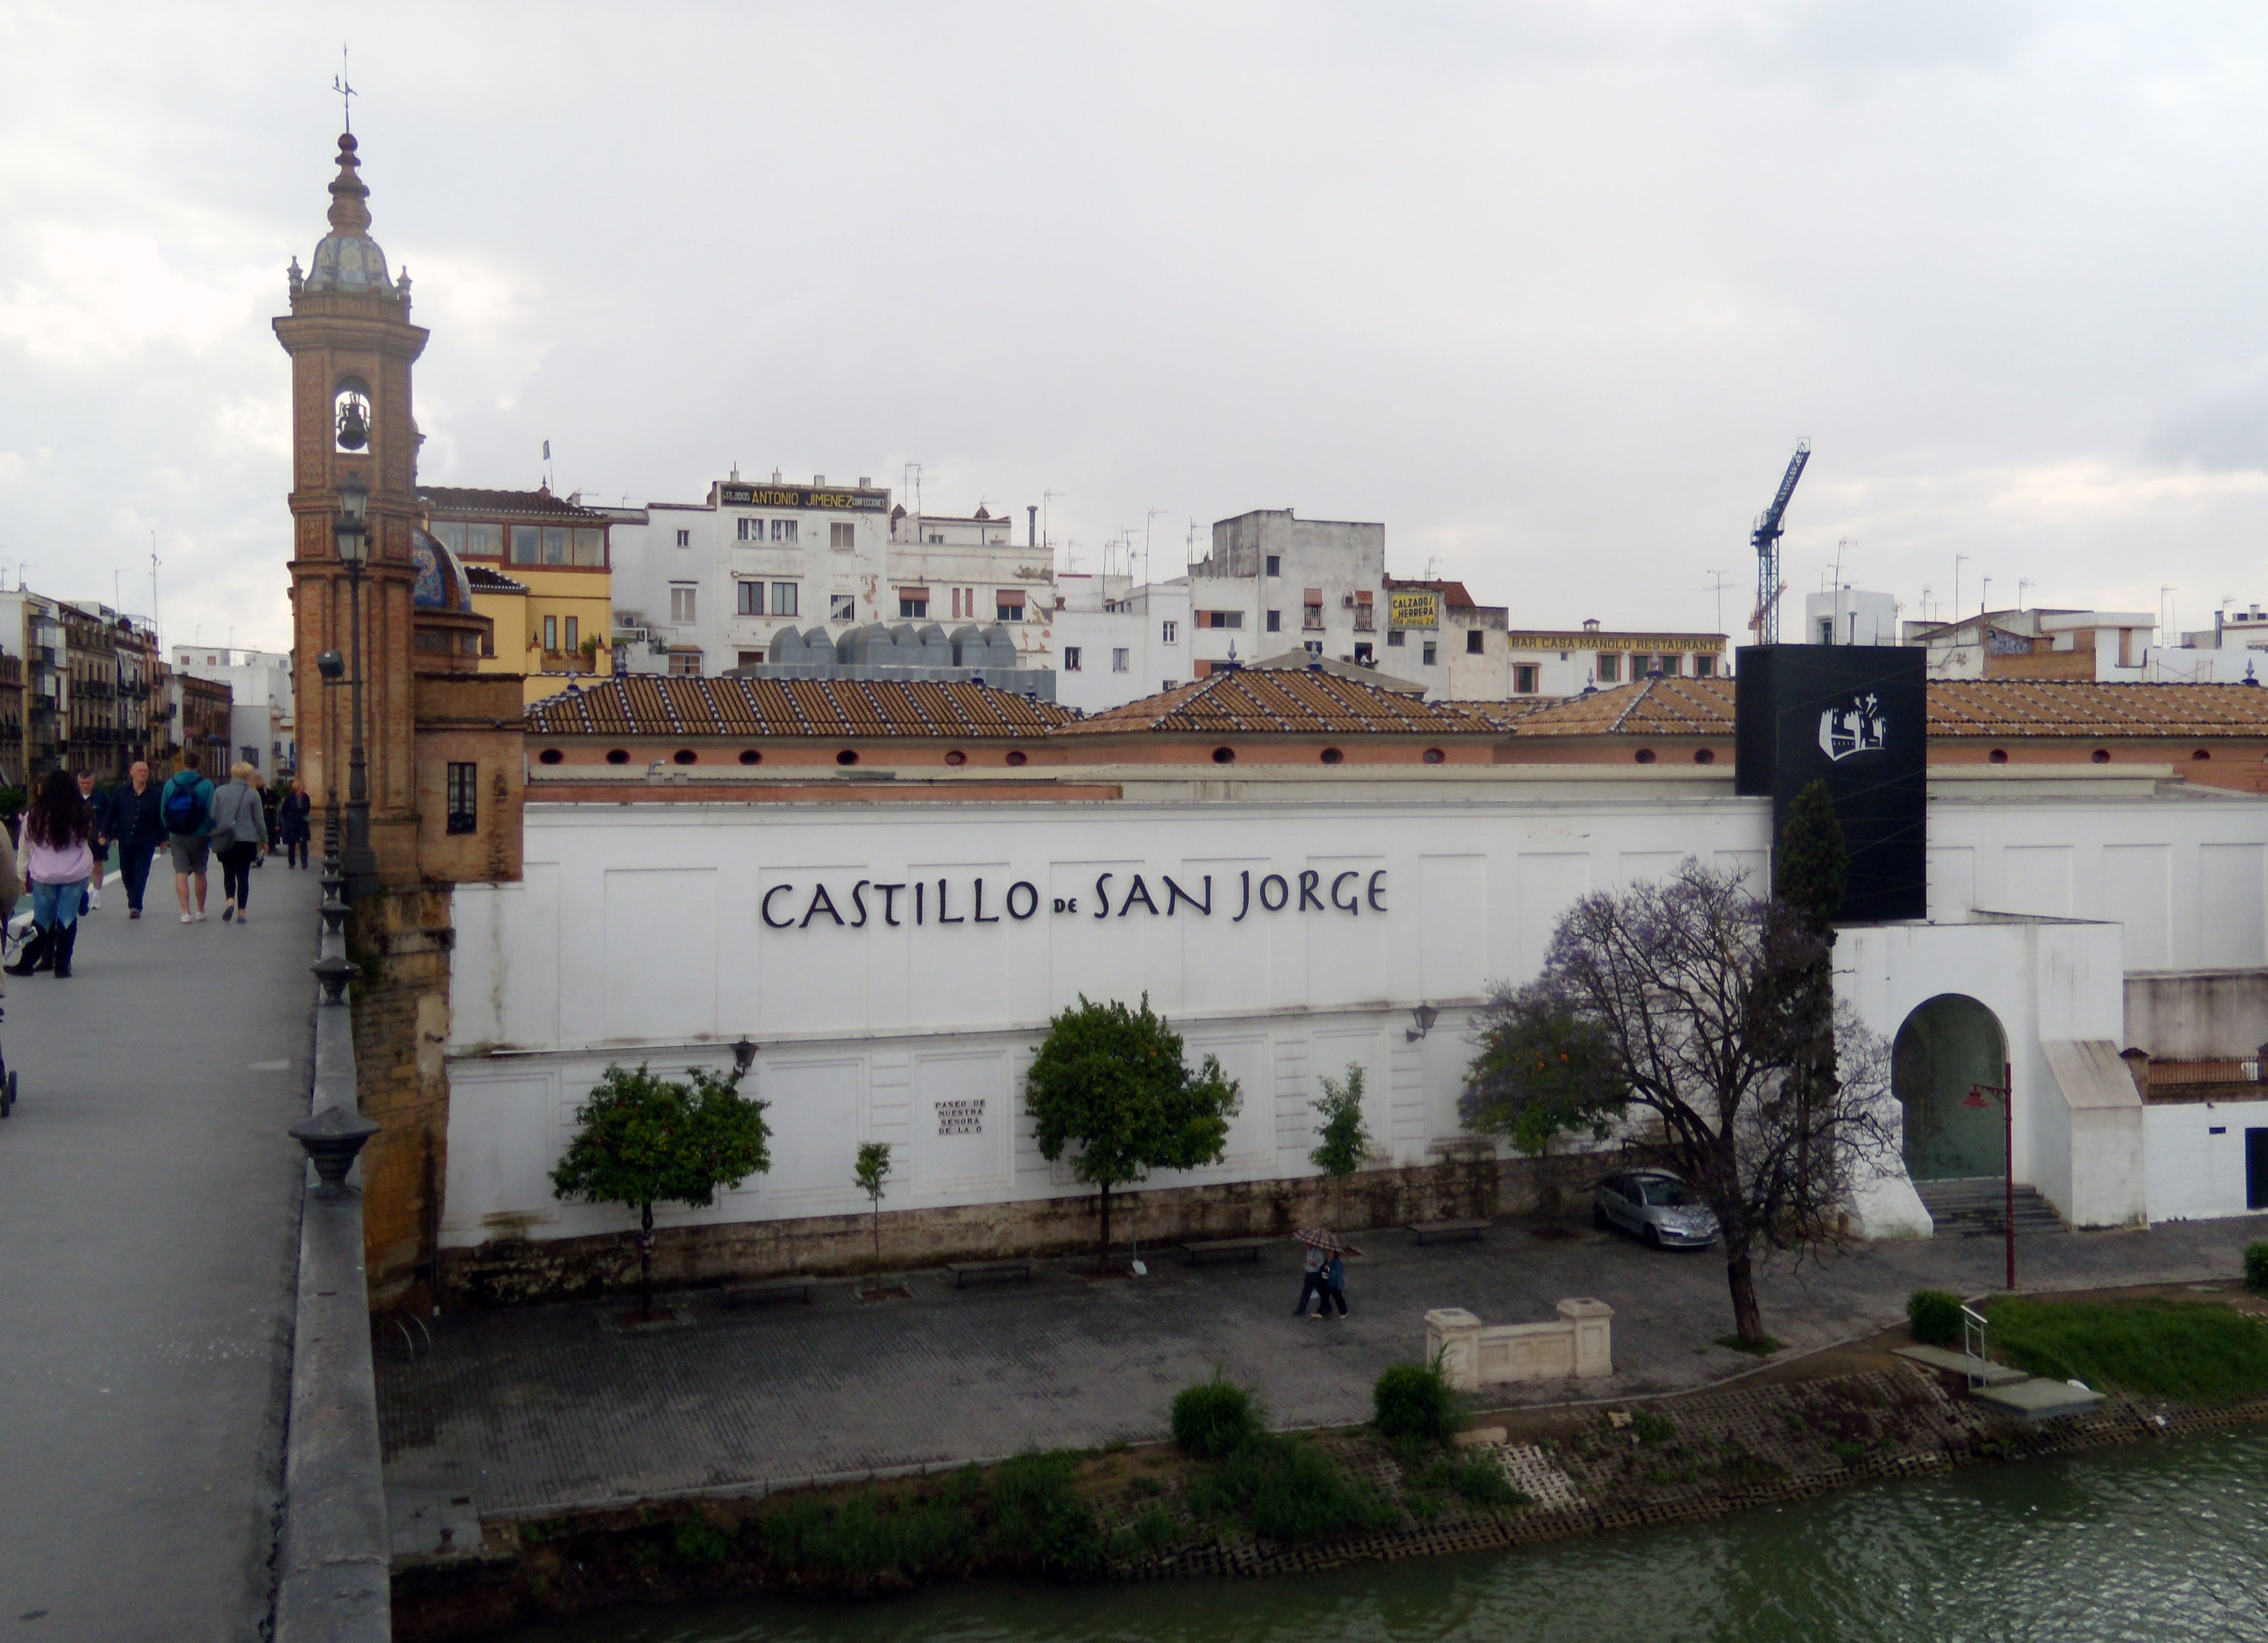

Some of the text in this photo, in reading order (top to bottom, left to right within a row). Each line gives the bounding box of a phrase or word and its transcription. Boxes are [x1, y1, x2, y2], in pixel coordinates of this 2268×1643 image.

[751, 490, 799, 506] ANTONIO
[805, 493, 853, 509] JIMENEZ
[1392, 597, 1432, 609] CALZADOS
[1398, 607, 1434, 618] HERRERA
[1512, 637, 1722, 651] BAR CASA MANOLO RESTAURANTE
[762, 870, 1388, 929] CASTILLO DE SAN JORGE
[935, 1100, 967, 1109] PASEO
[938, 1108, 983, 1117] NUESTRA
